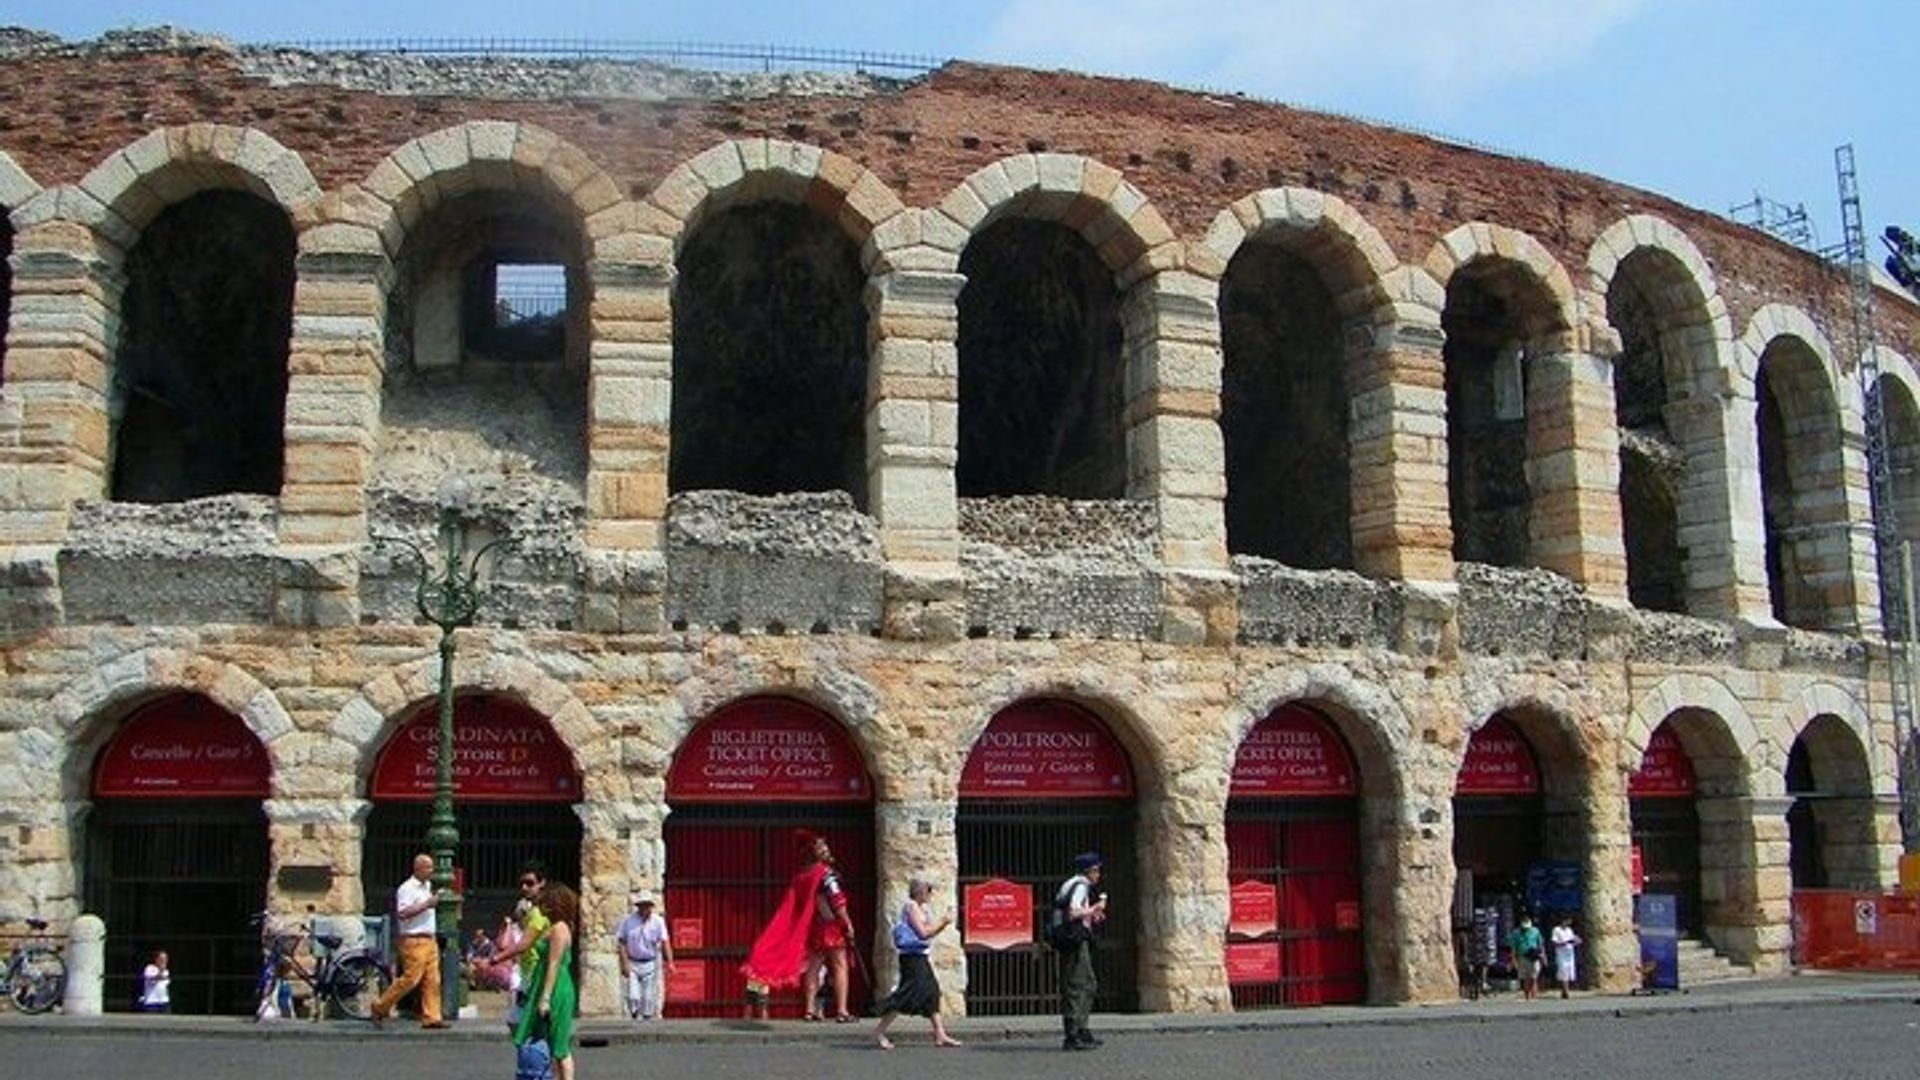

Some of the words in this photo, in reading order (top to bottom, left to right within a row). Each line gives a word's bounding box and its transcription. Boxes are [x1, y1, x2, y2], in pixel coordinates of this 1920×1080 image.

[409, 728, 546, 743] GRDINATA
[711, 730, 826, 744] BIGLIETTERIA
[981, 731, 1095, 747] POLTRONE
[131, 744, 191, 759] Cancello
[207, 745, 239, 759] Gate
[427, 746, 505, 761] STTORE
[707, 745, 768, 761] TICKET
[771, 746, 831, 761] OFFICE
[1278, 746, 1322, 761] OFFICE
[488, 764, 526, 776] Gate
[528, 764, 539, 776] 6
[704, 764, 769, 776] Cancello
[786, 764, 822, 776] Gate
[824, 764, 834, 776] 7
[983, 761, 1034, 773] Entrata
[1049, 761, 1081, 773] Gate
[1084, 761, 1095, 773] 8
[1289, 765, 1316, 776] Gate
